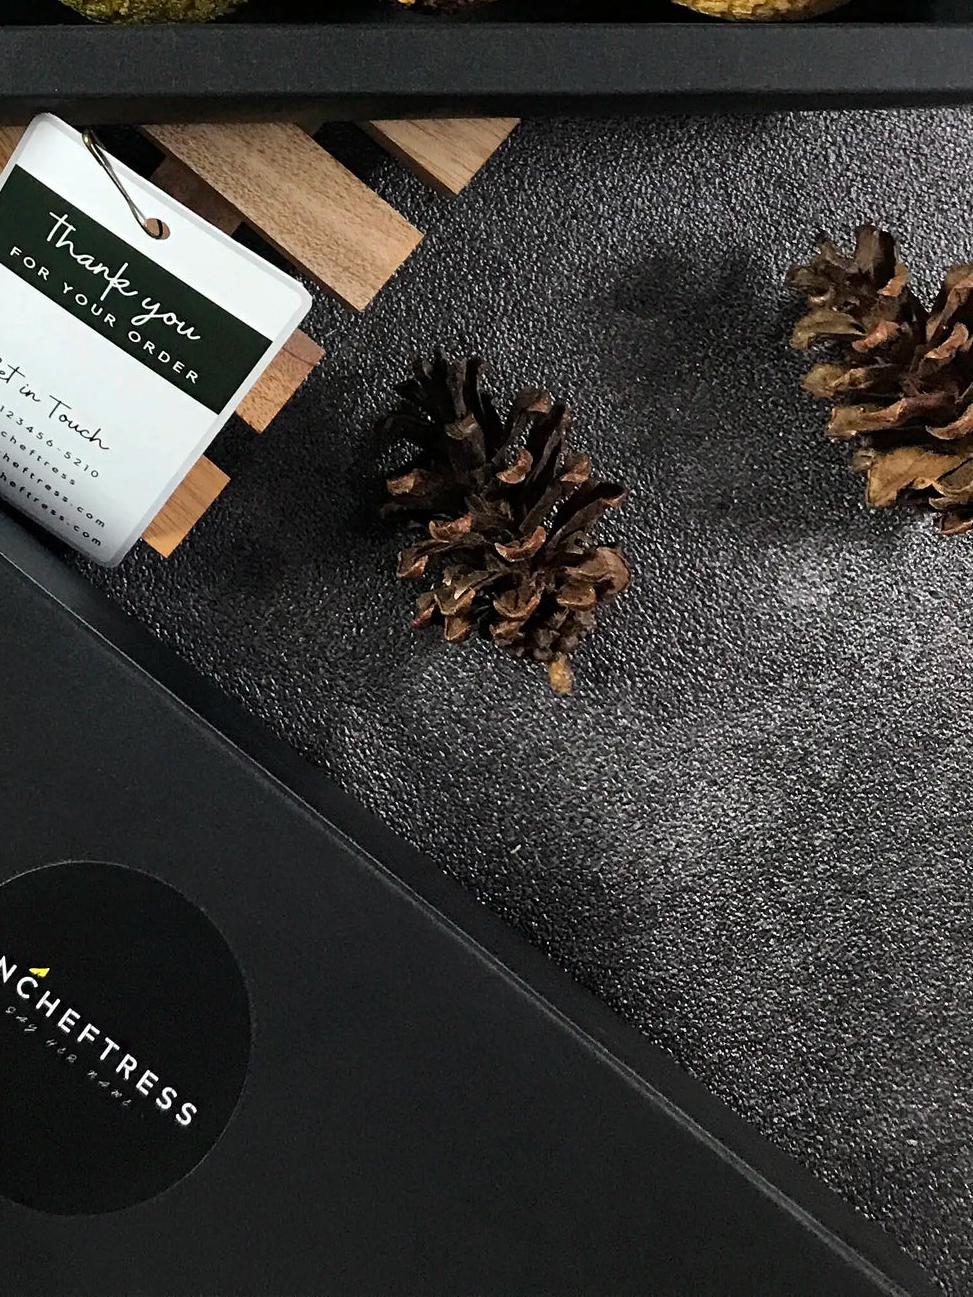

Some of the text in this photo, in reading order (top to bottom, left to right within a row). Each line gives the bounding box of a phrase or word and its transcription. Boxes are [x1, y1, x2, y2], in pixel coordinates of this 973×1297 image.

[9, 246, 199, 384] FOR YOUR ORDER
[130, 297, 201, 340] you
[19, 383, 41, 402] in
[49, 394, 110, 450] Touch
